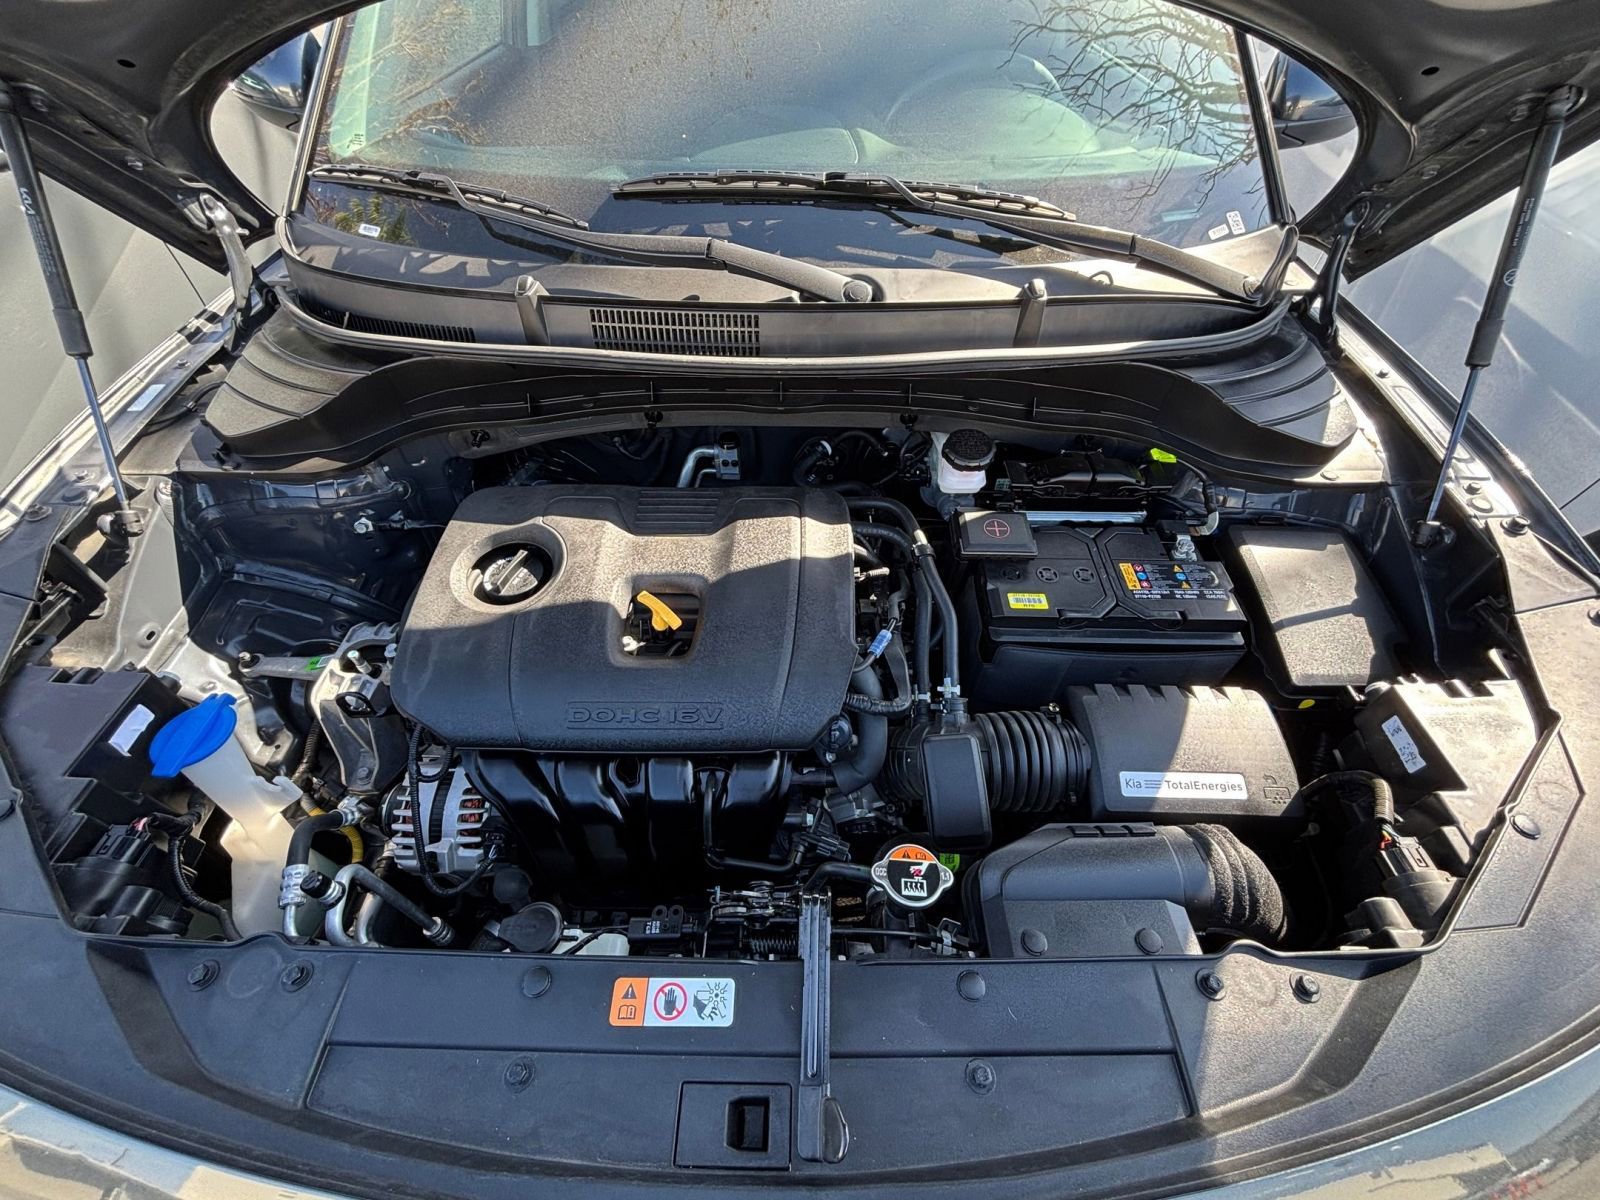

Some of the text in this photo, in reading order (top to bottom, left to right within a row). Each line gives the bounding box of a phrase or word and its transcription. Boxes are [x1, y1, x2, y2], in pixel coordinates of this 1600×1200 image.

[568, 707, 724, 723] DOHC 16V
[1125, 778, 1243, 792] Kia TotalEnergies
